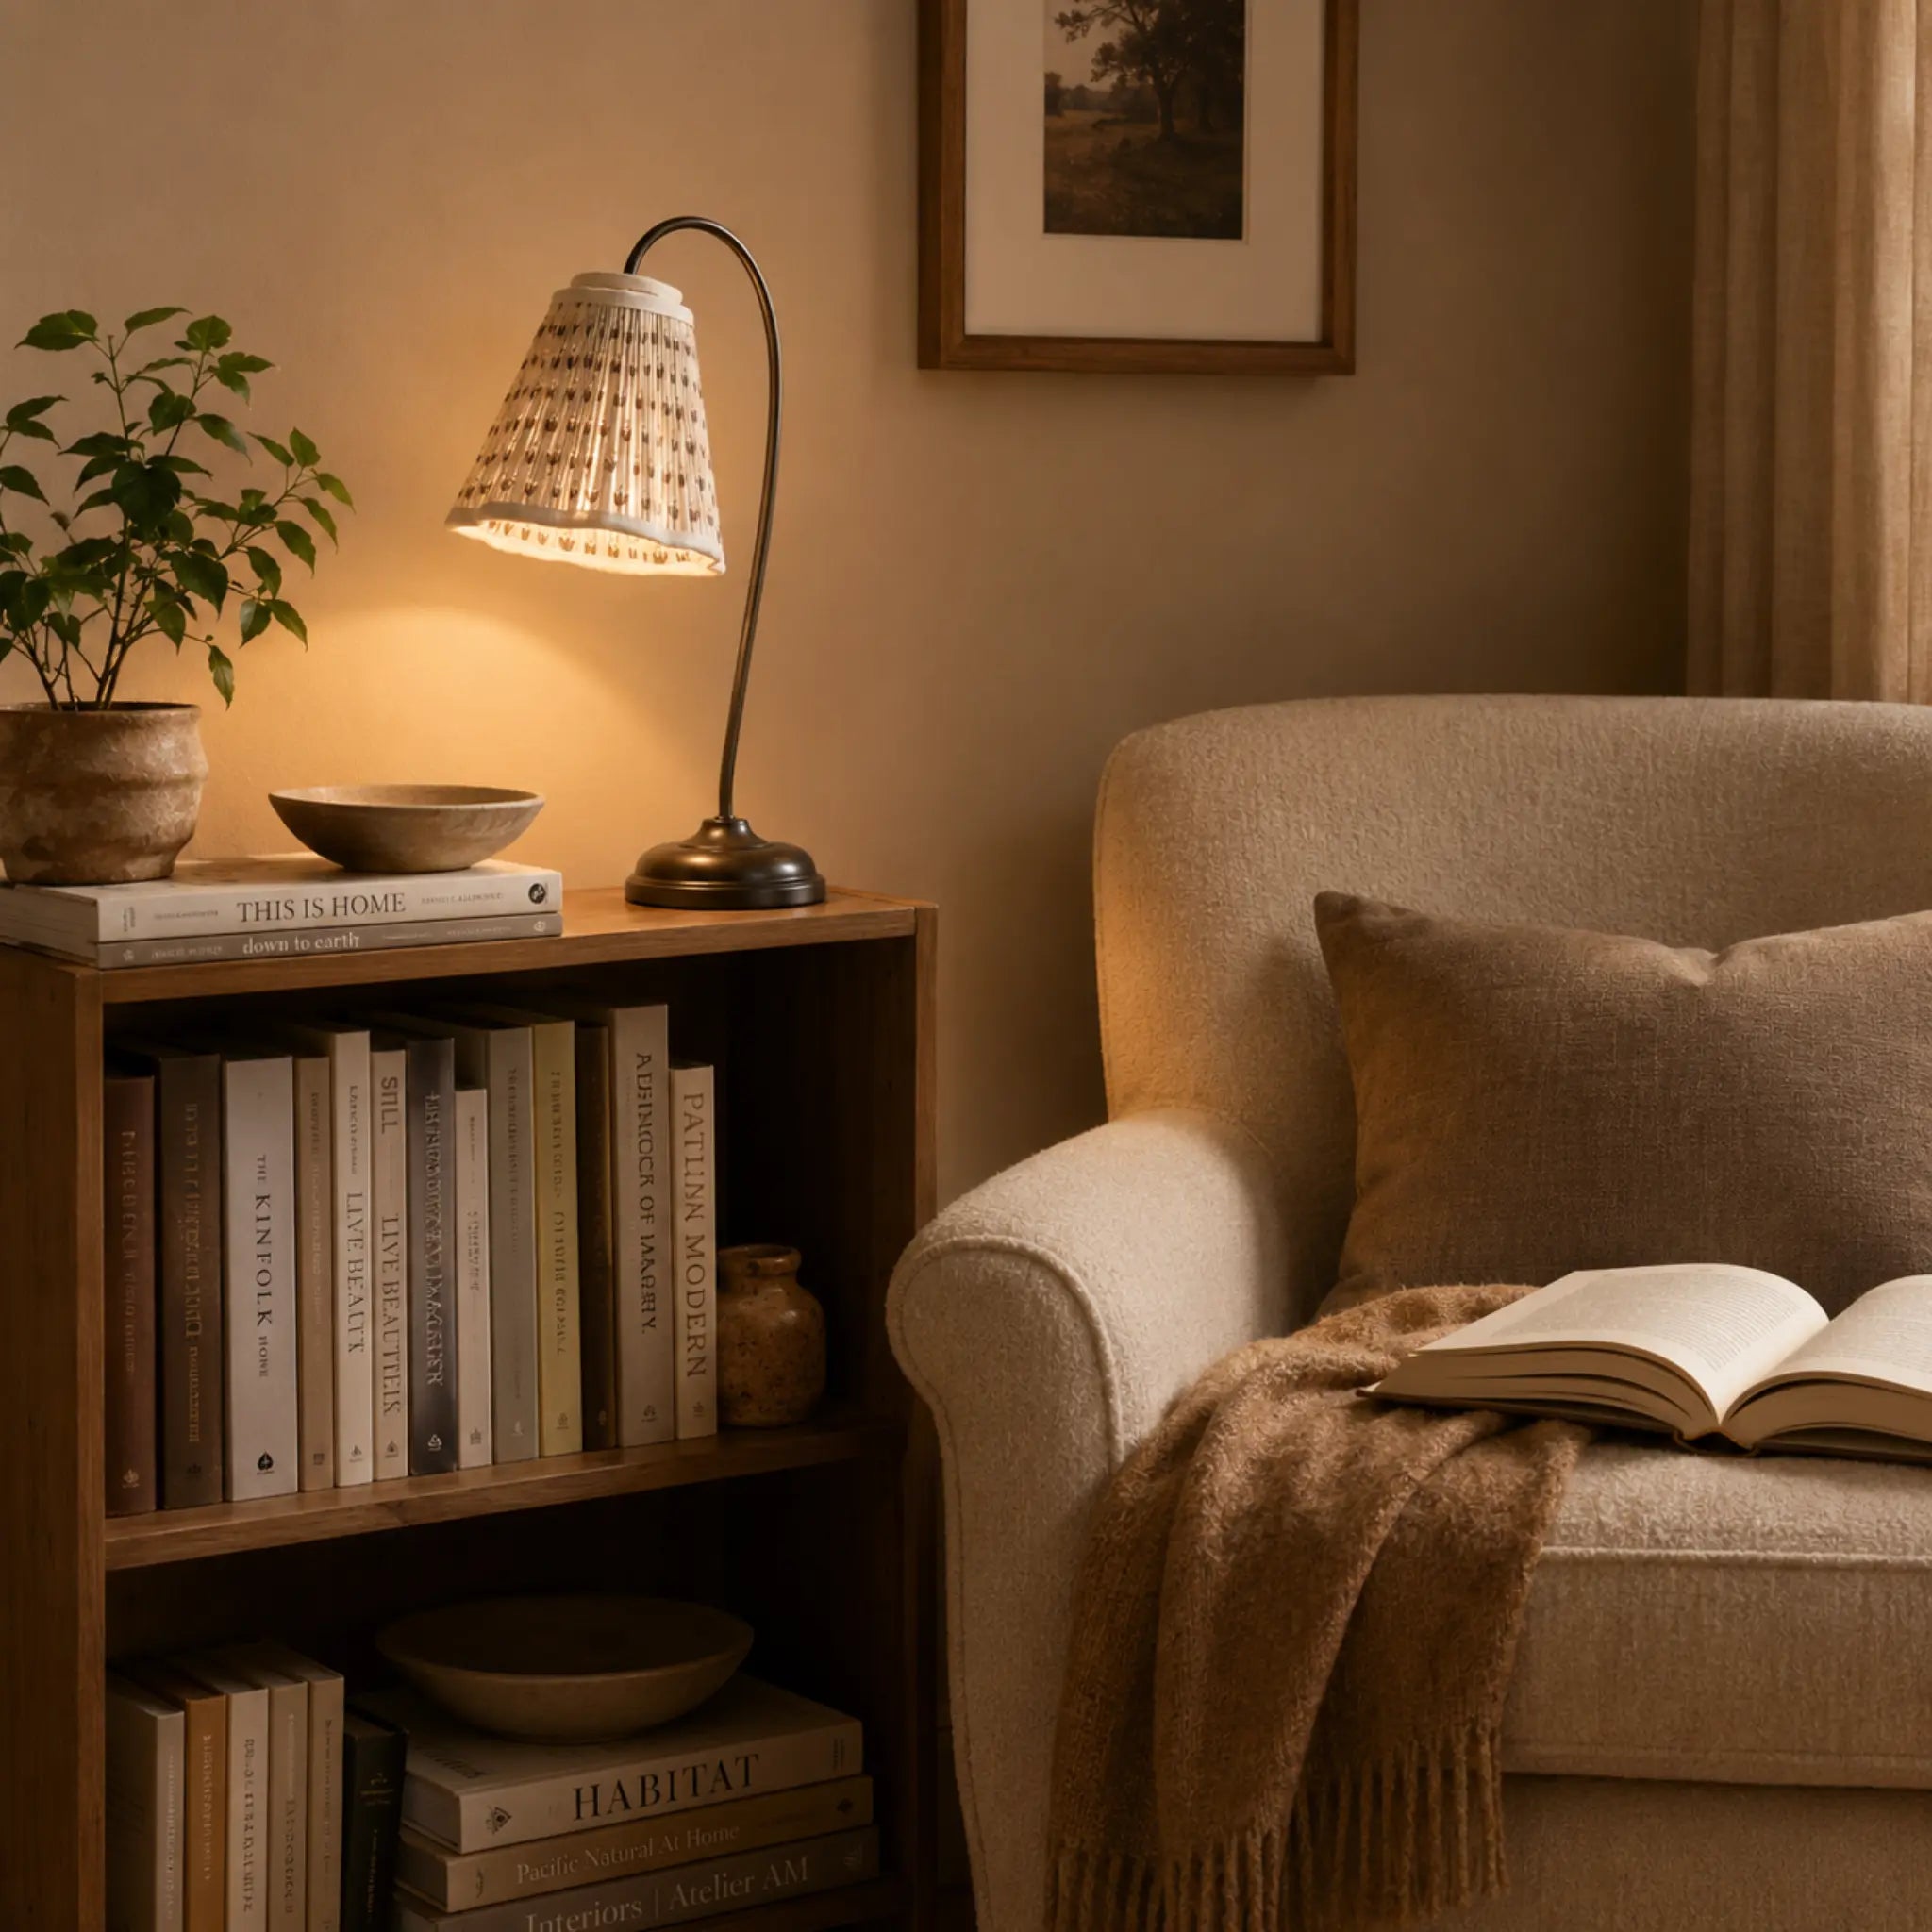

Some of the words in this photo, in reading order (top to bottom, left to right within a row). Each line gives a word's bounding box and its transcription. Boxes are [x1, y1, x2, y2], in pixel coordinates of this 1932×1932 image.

[237, 898, 295, 923] THIS
[303, 897, 325, 920] IS
[331, 892, 407, 918] HOME
[242, 936, 290, 955] down
[294, 935, 311, 952] to
[314, 931, 360, 950] earth
[346, 1192, 365, 1252] LIVE
[640, 1195, 655, 1225] OF
[255, 1193, 273, 1327] KINFOLK
[381, 1214, 401, 1273] LIVE
[685, 1234, 708, 1378] MODERN
[574, 1753, 759, 1822] HABITAT
[517, 1853, 578, 1884] Pacific
[585, 1837, 654, 1868] Natural
[659, 1834, 680, 1855] At
[687, 1825, 741, 1850] Home
[525, 1898, 643, 1932] Interiors
[669, 1872, 755, 1911] Atelier
[762, 1855, 809, 1890] AM
